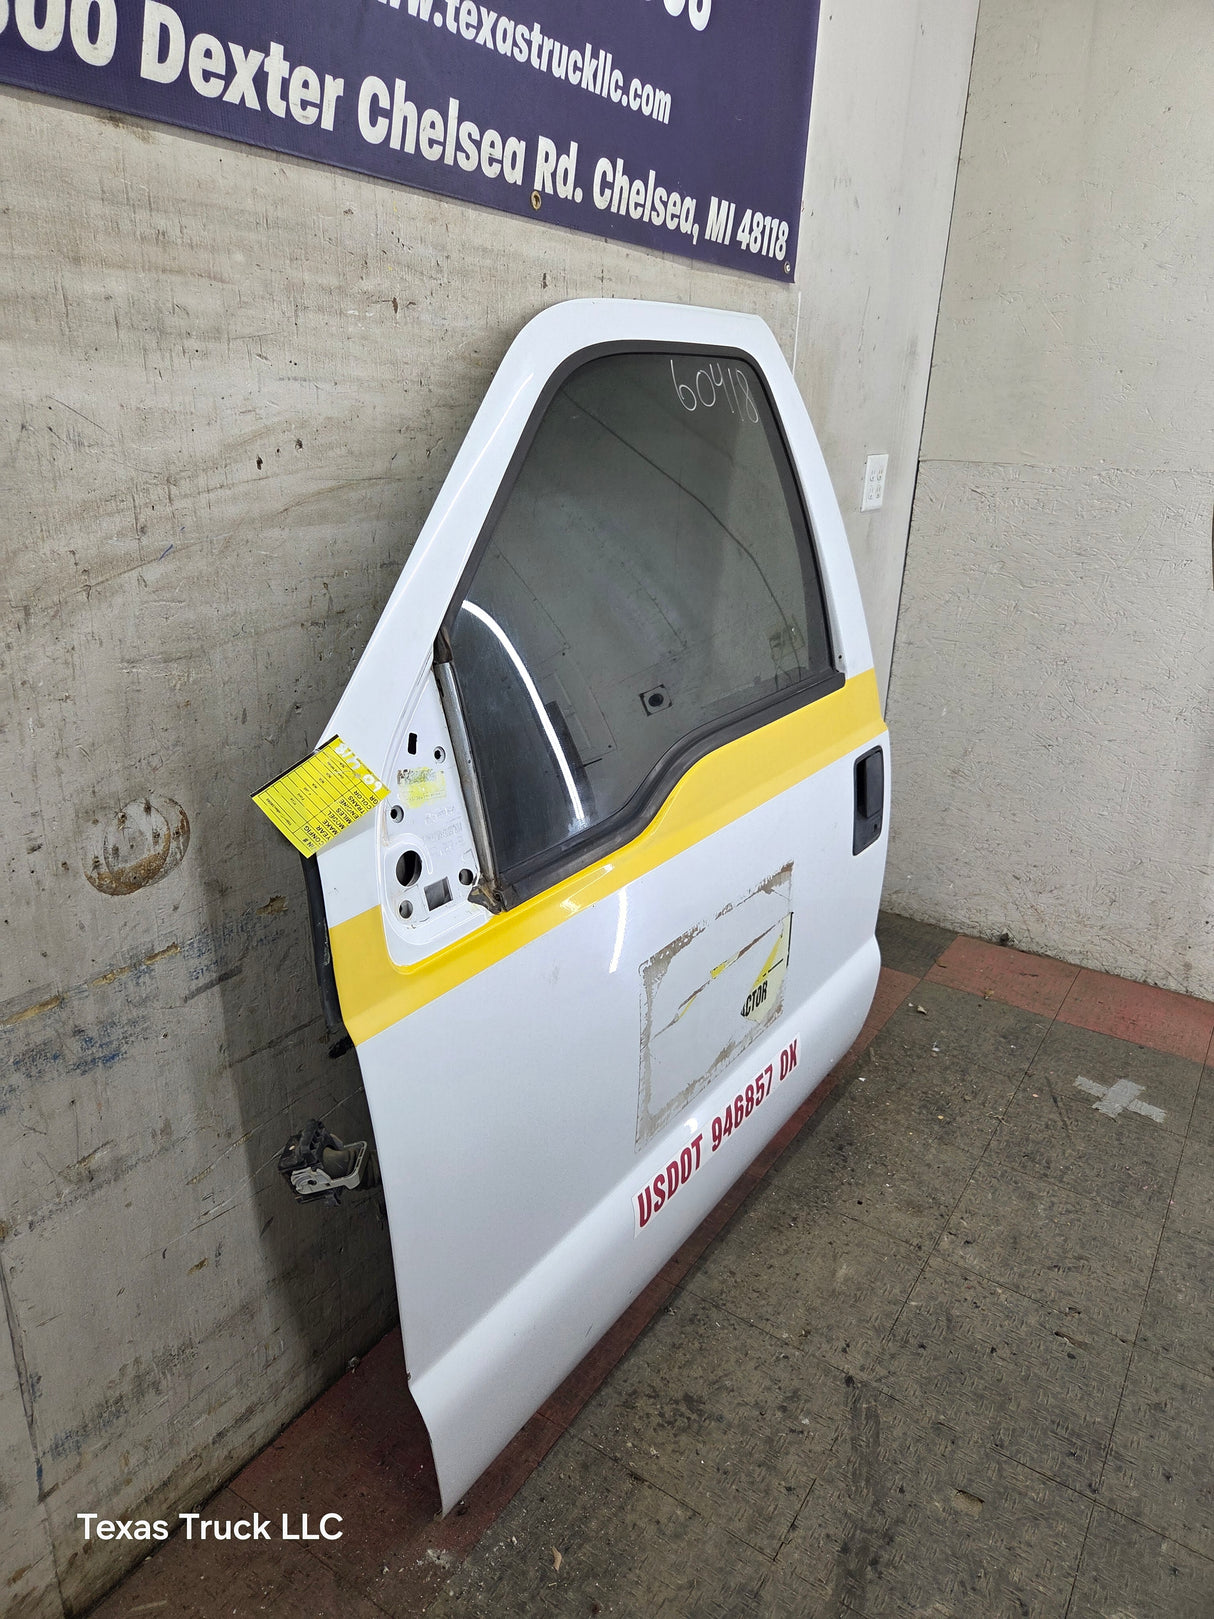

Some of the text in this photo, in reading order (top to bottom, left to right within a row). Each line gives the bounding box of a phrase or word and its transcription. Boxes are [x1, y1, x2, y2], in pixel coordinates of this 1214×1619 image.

[378, 0, 672, 124] w.texastruckllc.com
[0, 0, 789, 261] 00 Dexter Chelsea Rd. Chelsea, MI 48118
[670, 359, 759, 423] 60418
[347, 795, 365, 814] TRANS
[353, 790, 372, 810] COLOR
[327, 810, 345, 830] MODEL
[335, 807, 352, 824] MILES
[303, 825, 325, 846] CONFIG
[315, 825, 331, 841] YEAR
[322, 818, 338, 835] MAKE
[637, 1133, 703, 1228] USDOT
[711, 1063, 773, 1152] 946857
